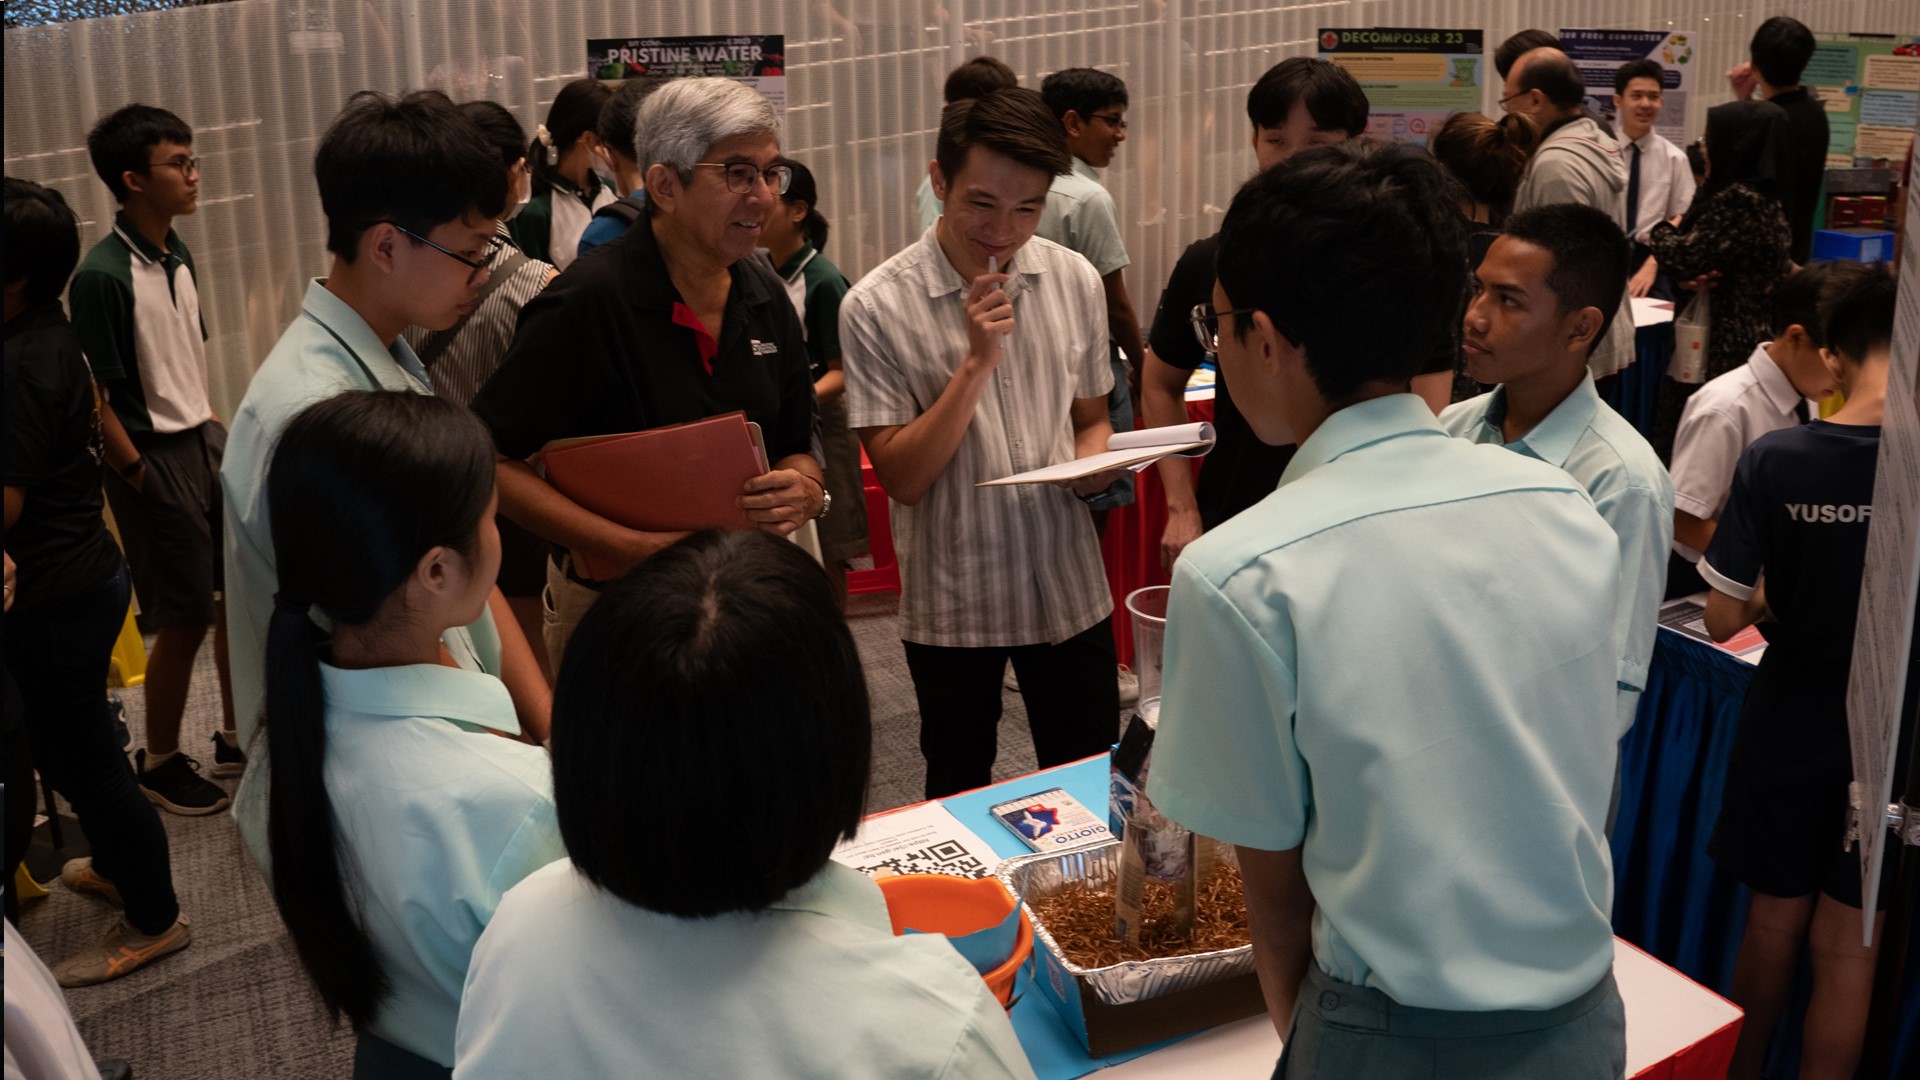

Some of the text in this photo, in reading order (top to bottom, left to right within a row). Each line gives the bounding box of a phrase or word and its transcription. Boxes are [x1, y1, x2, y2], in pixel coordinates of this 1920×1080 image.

[1341, 31, 1463, 44] DECOMPOSER 23
[607, 45, 763, 64] PRISTINE WATER
[1784, 503, 1872, 524] YUSOF
[1055, 825, 1107, 844] GIOTTO
